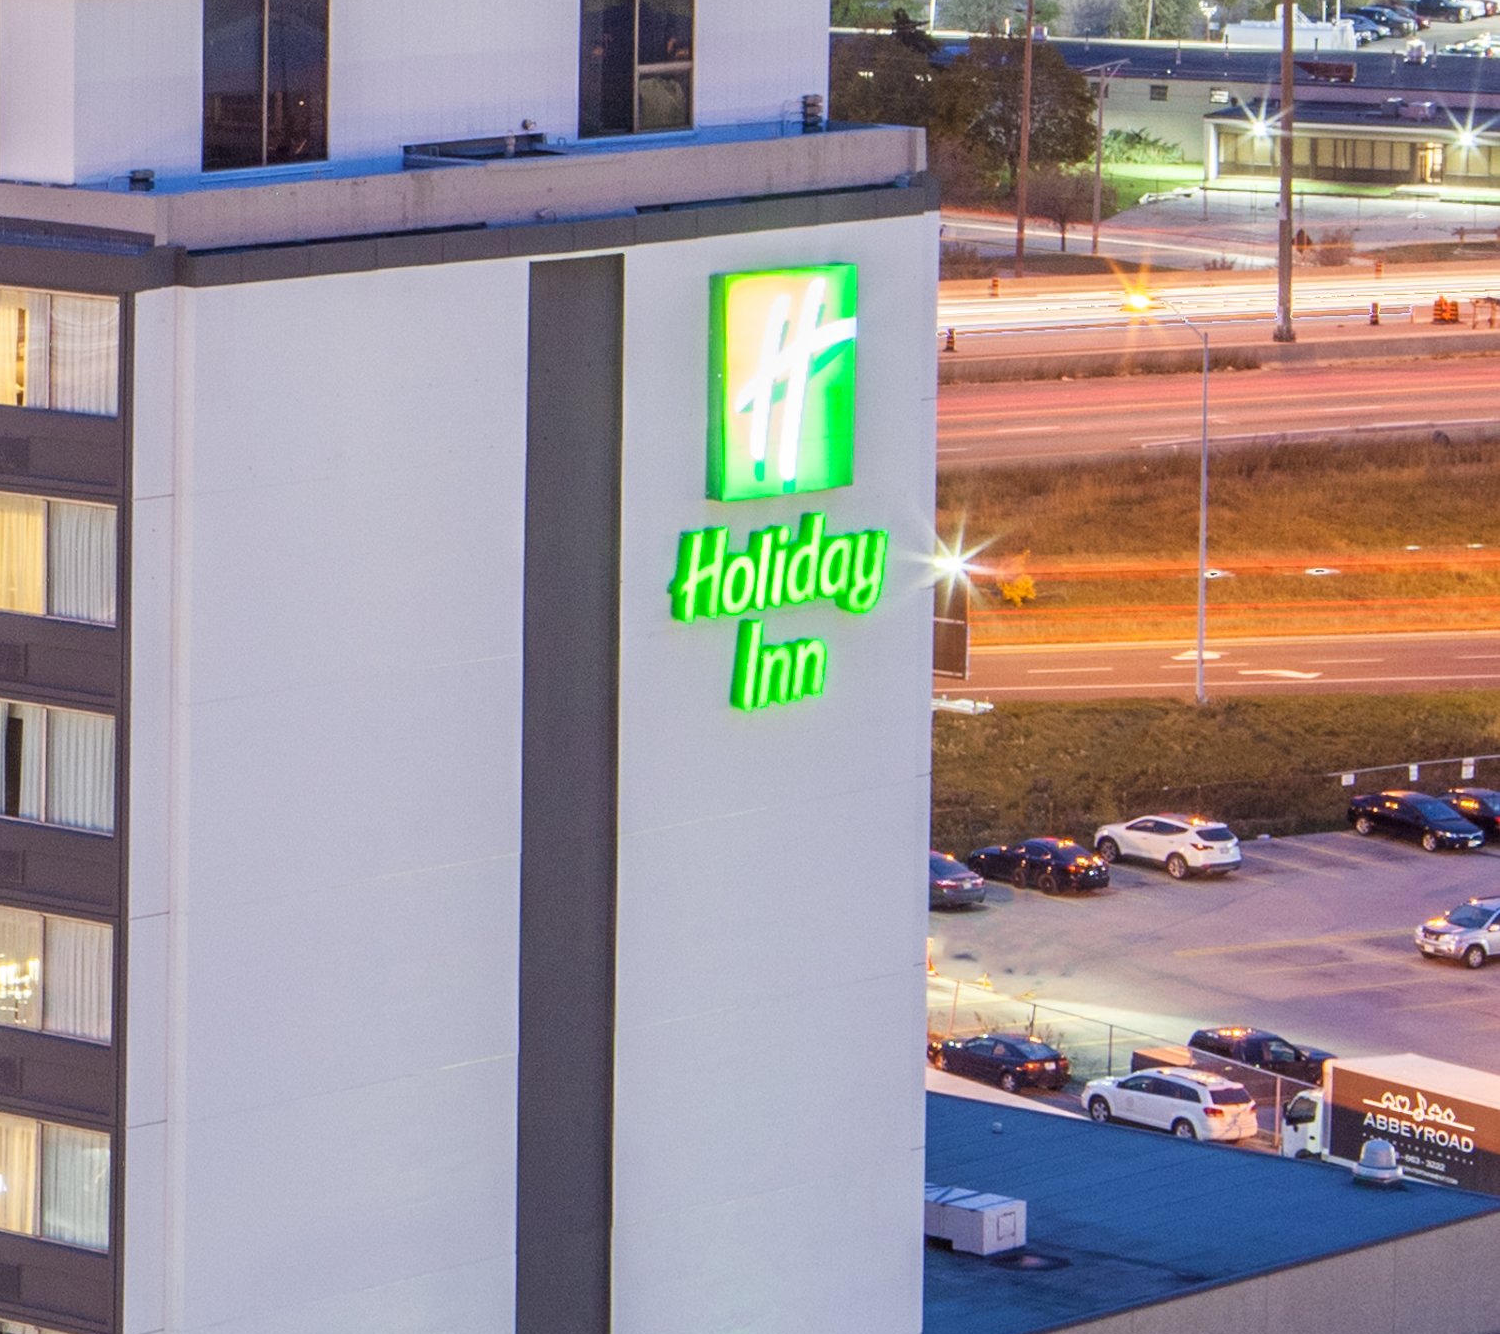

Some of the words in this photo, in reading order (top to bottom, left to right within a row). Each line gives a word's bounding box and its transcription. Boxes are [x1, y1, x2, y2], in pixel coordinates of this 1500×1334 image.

[670, 512, 889, 623] Holiday
[730, 619, 828, 712] Inn
[1362, 1112, 1475, 1154] ABBEYROAD
